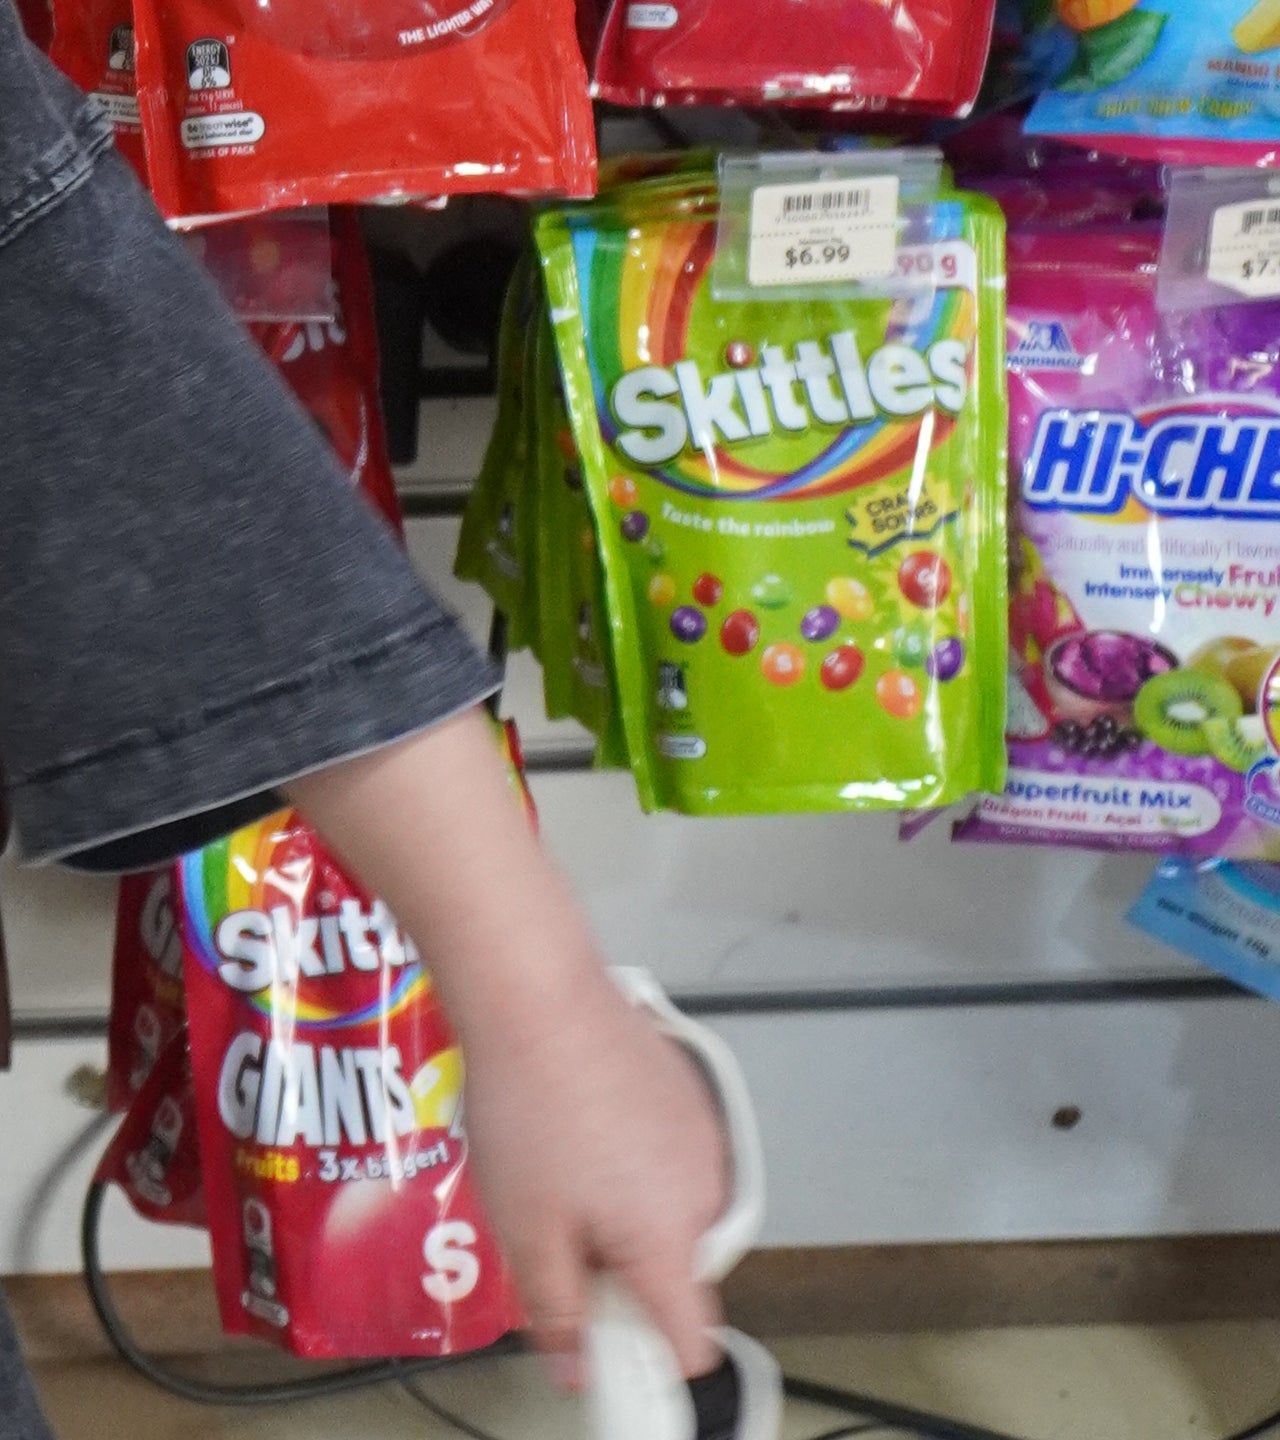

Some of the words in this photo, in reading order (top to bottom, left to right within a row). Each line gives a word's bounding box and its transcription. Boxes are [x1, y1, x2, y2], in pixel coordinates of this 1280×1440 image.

[398, 27, 426, 46] THE
[425, 11, 473, 40] LIGHTER
[191, 43, 222, 56] ENERGY
[230, 145, 256, 155] PACK
[784, 244, 851, 269] $6.99
[940, 254, 958, 279] g
[610, 328, 971, 468] Skittles
[662, 500, 713, 532] Taste
[715, 517, 751, 537] the
[752, 519, 836, 538] rainbow
[1119, 535, 1144, 555] and
[1173, 584, 1276, 618] Chewy
[1139, 789, 1193, 810] Mix
[217, 1030, 419, 1147] GIANTS
[317, 1154, 361, 1182] 3x
